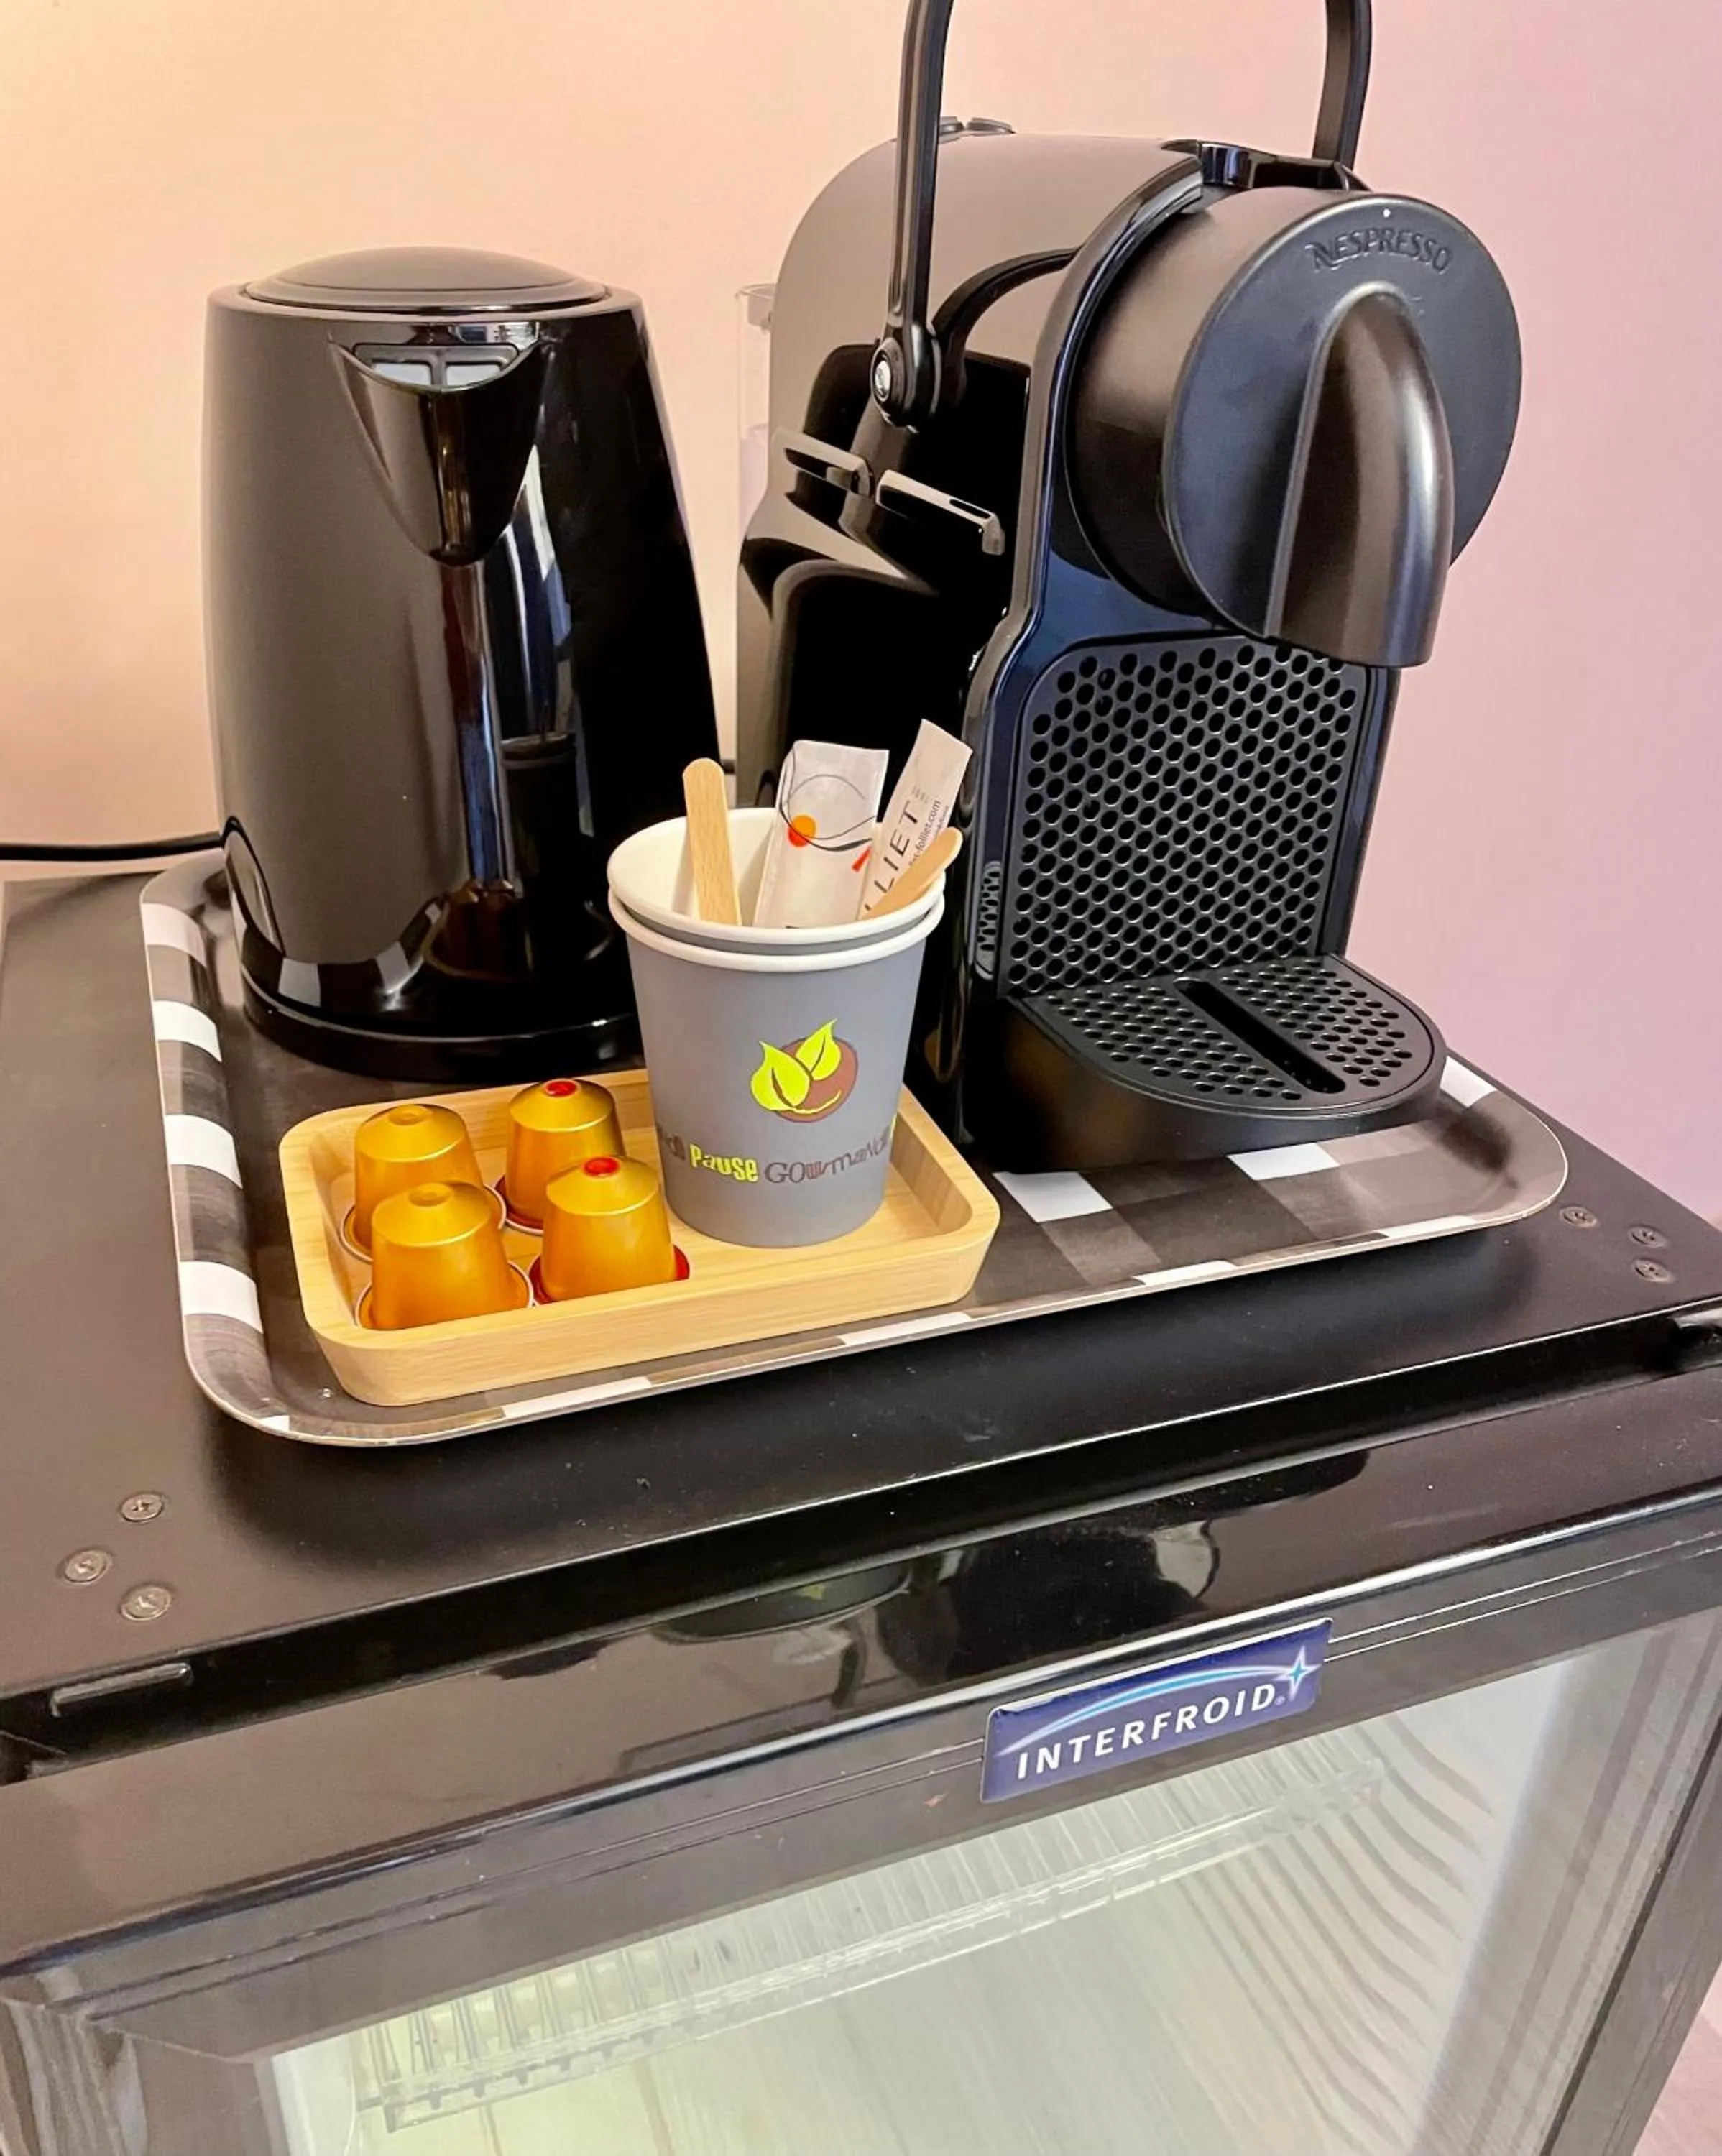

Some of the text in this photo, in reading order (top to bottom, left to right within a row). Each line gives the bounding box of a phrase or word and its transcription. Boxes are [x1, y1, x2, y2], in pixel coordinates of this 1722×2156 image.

[1304, 226, 1452, 275] NESPRESSO
[689, 1142, 760, 1183] Pause
[1016, 1683, 1276, 1780] INTERFROID
